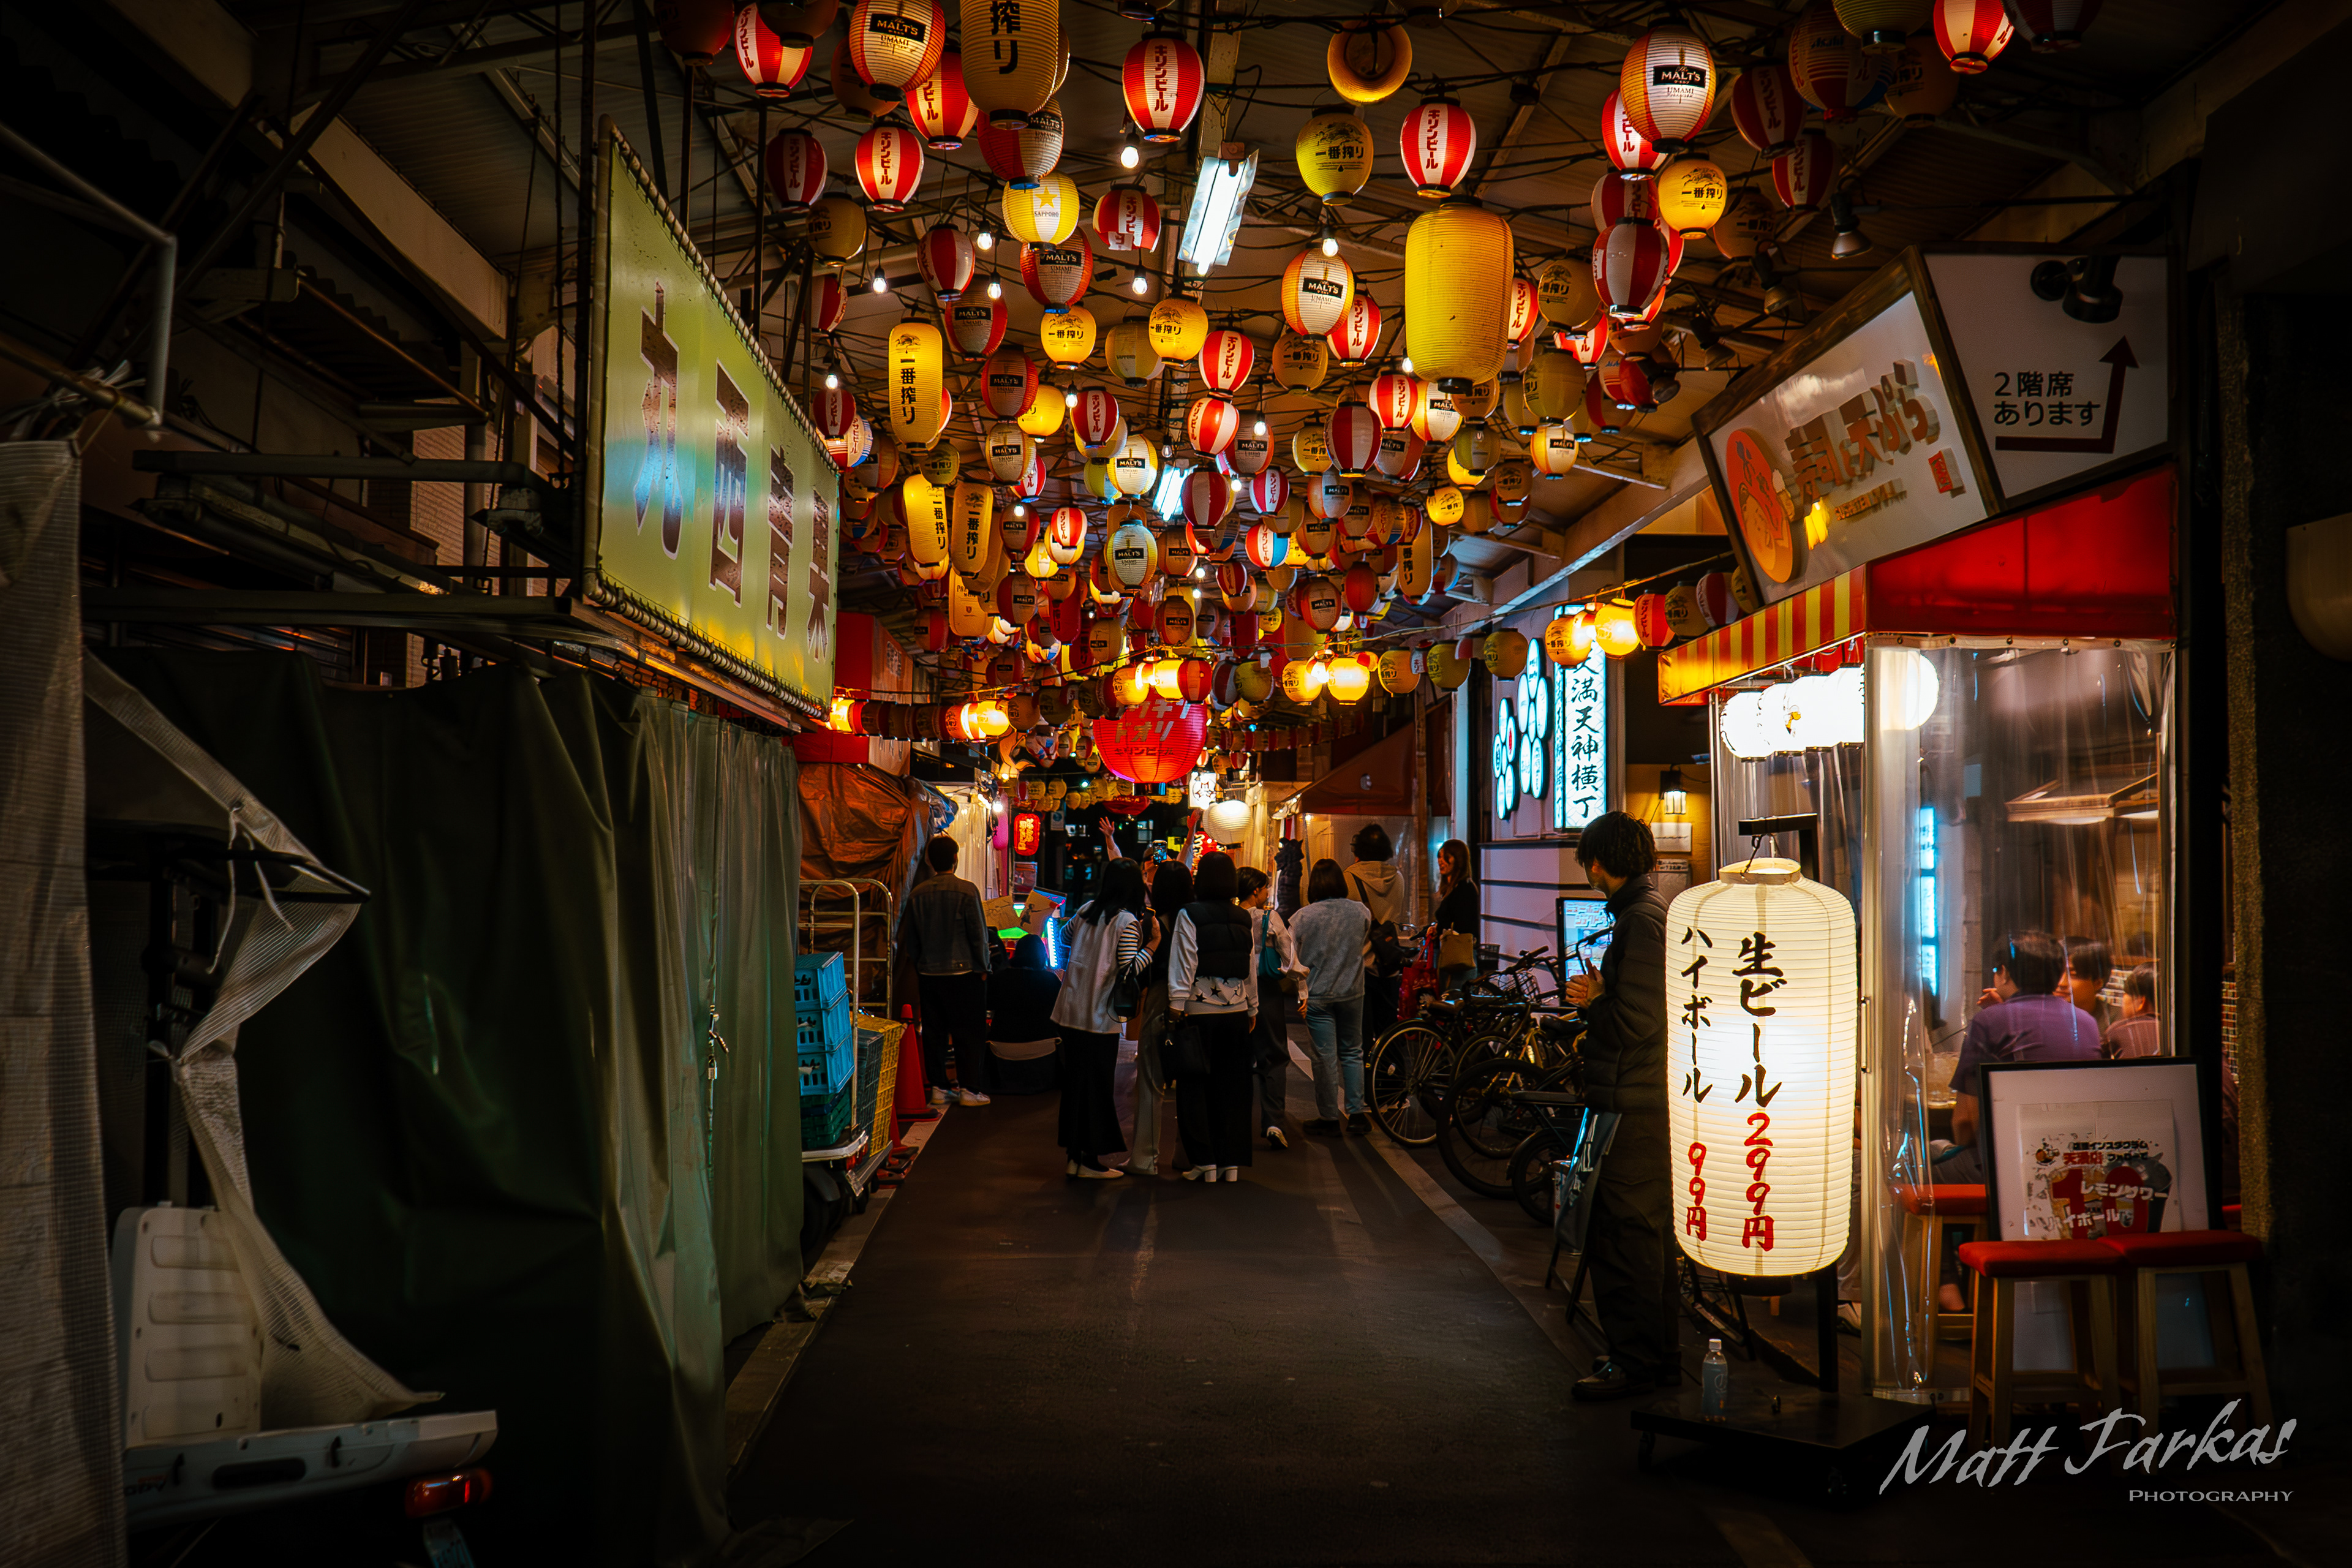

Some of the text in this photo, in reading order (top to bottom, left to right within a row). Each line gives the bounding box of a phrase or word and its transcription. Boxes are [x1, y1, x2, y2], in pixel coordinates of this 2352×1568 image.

[876, 20, 918, 36] MALT'S
[1155, 44, 1169, 111] キリンビール
[1661, 72, 1701, 81] MALT'S
[880, 131, 892, 185] キリンビール
[1315, 145, 1363, 160] 一番搾り
[1425, 109, 1440, 169] キリンビール
[1681, 187, 1722, 200] 一番搾り
[1044, 253, 1077, 263] MALT'S
[1308, 282, 1339, 295] MALT'S
[1512, 282, 1526, 328] キリンビール
[1048, 330, 1084, 339] 一番搾り
[1150, 324, 1182, 335] 一番搾り
[1352, 299, 1363, 347] キリンビール
[1221, 336, 1238, 379] キリンビール
[900, 358, 916, 424] 一番搾り
[1396, 379, 1405, 418] キリンビール
[1092, 394, 1101, 433] キリンビール
[1190, 402, 1204, 440] キリンビール
[1994, 401, 2101, 426] あります
[933, 501, 946, 550] 一番搾り
[966, 510, 981, 560] 一番搾り
[1681, 925, 1713, 1242] ハイボール 99円
[1732, 932, 1787, 1253] 生ビール 299円
